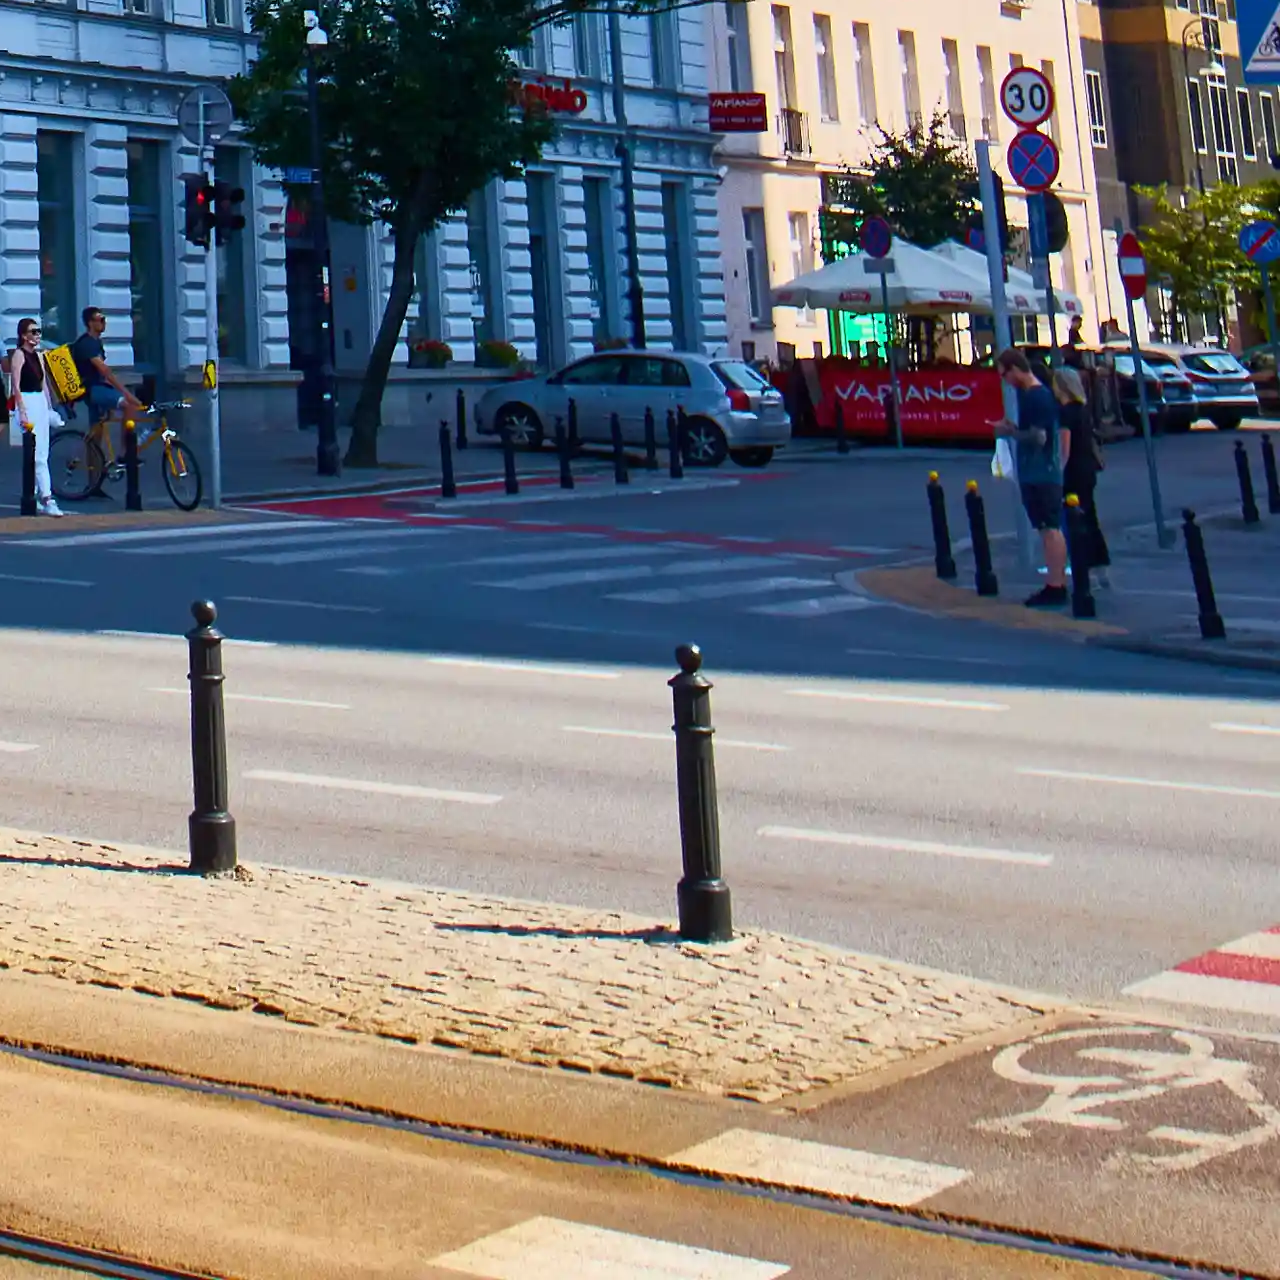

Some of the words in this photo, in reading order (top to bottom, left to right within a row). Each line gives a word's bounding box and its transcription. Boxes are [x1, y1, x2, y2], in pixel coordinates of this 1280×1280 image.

[1008, 83, 1046, 113] 30
[60, 358, 78, 393] Glovo
[835, 379, 972, 406] VAPIANO
